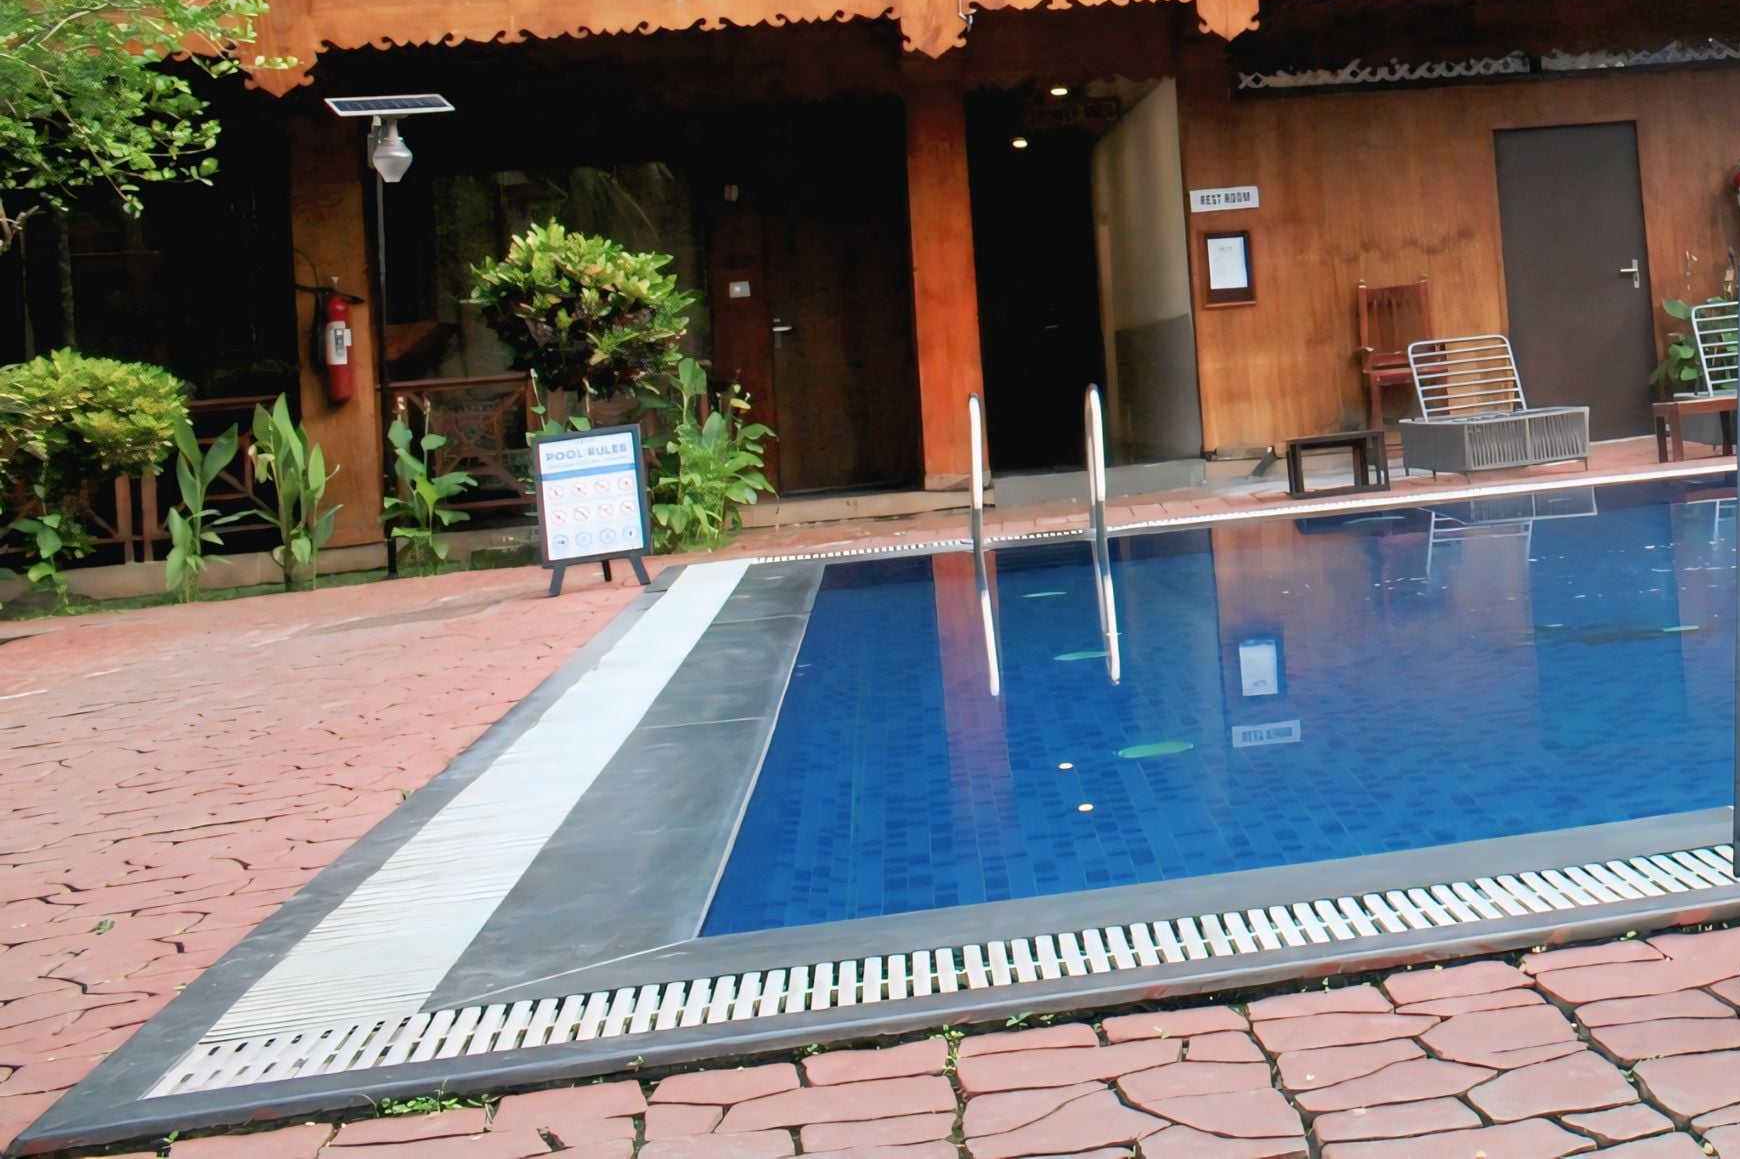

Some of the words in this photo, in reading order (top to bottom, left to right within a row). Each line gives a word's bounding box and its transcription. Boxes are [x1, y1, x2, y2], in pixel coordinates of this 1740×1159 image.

[1200, 193, 1221, 205] REST
[1224, 191, 1250, 203] ROOM
[545, 449, 584, 461] POOL
[587, 443, 627, 456] RULES
